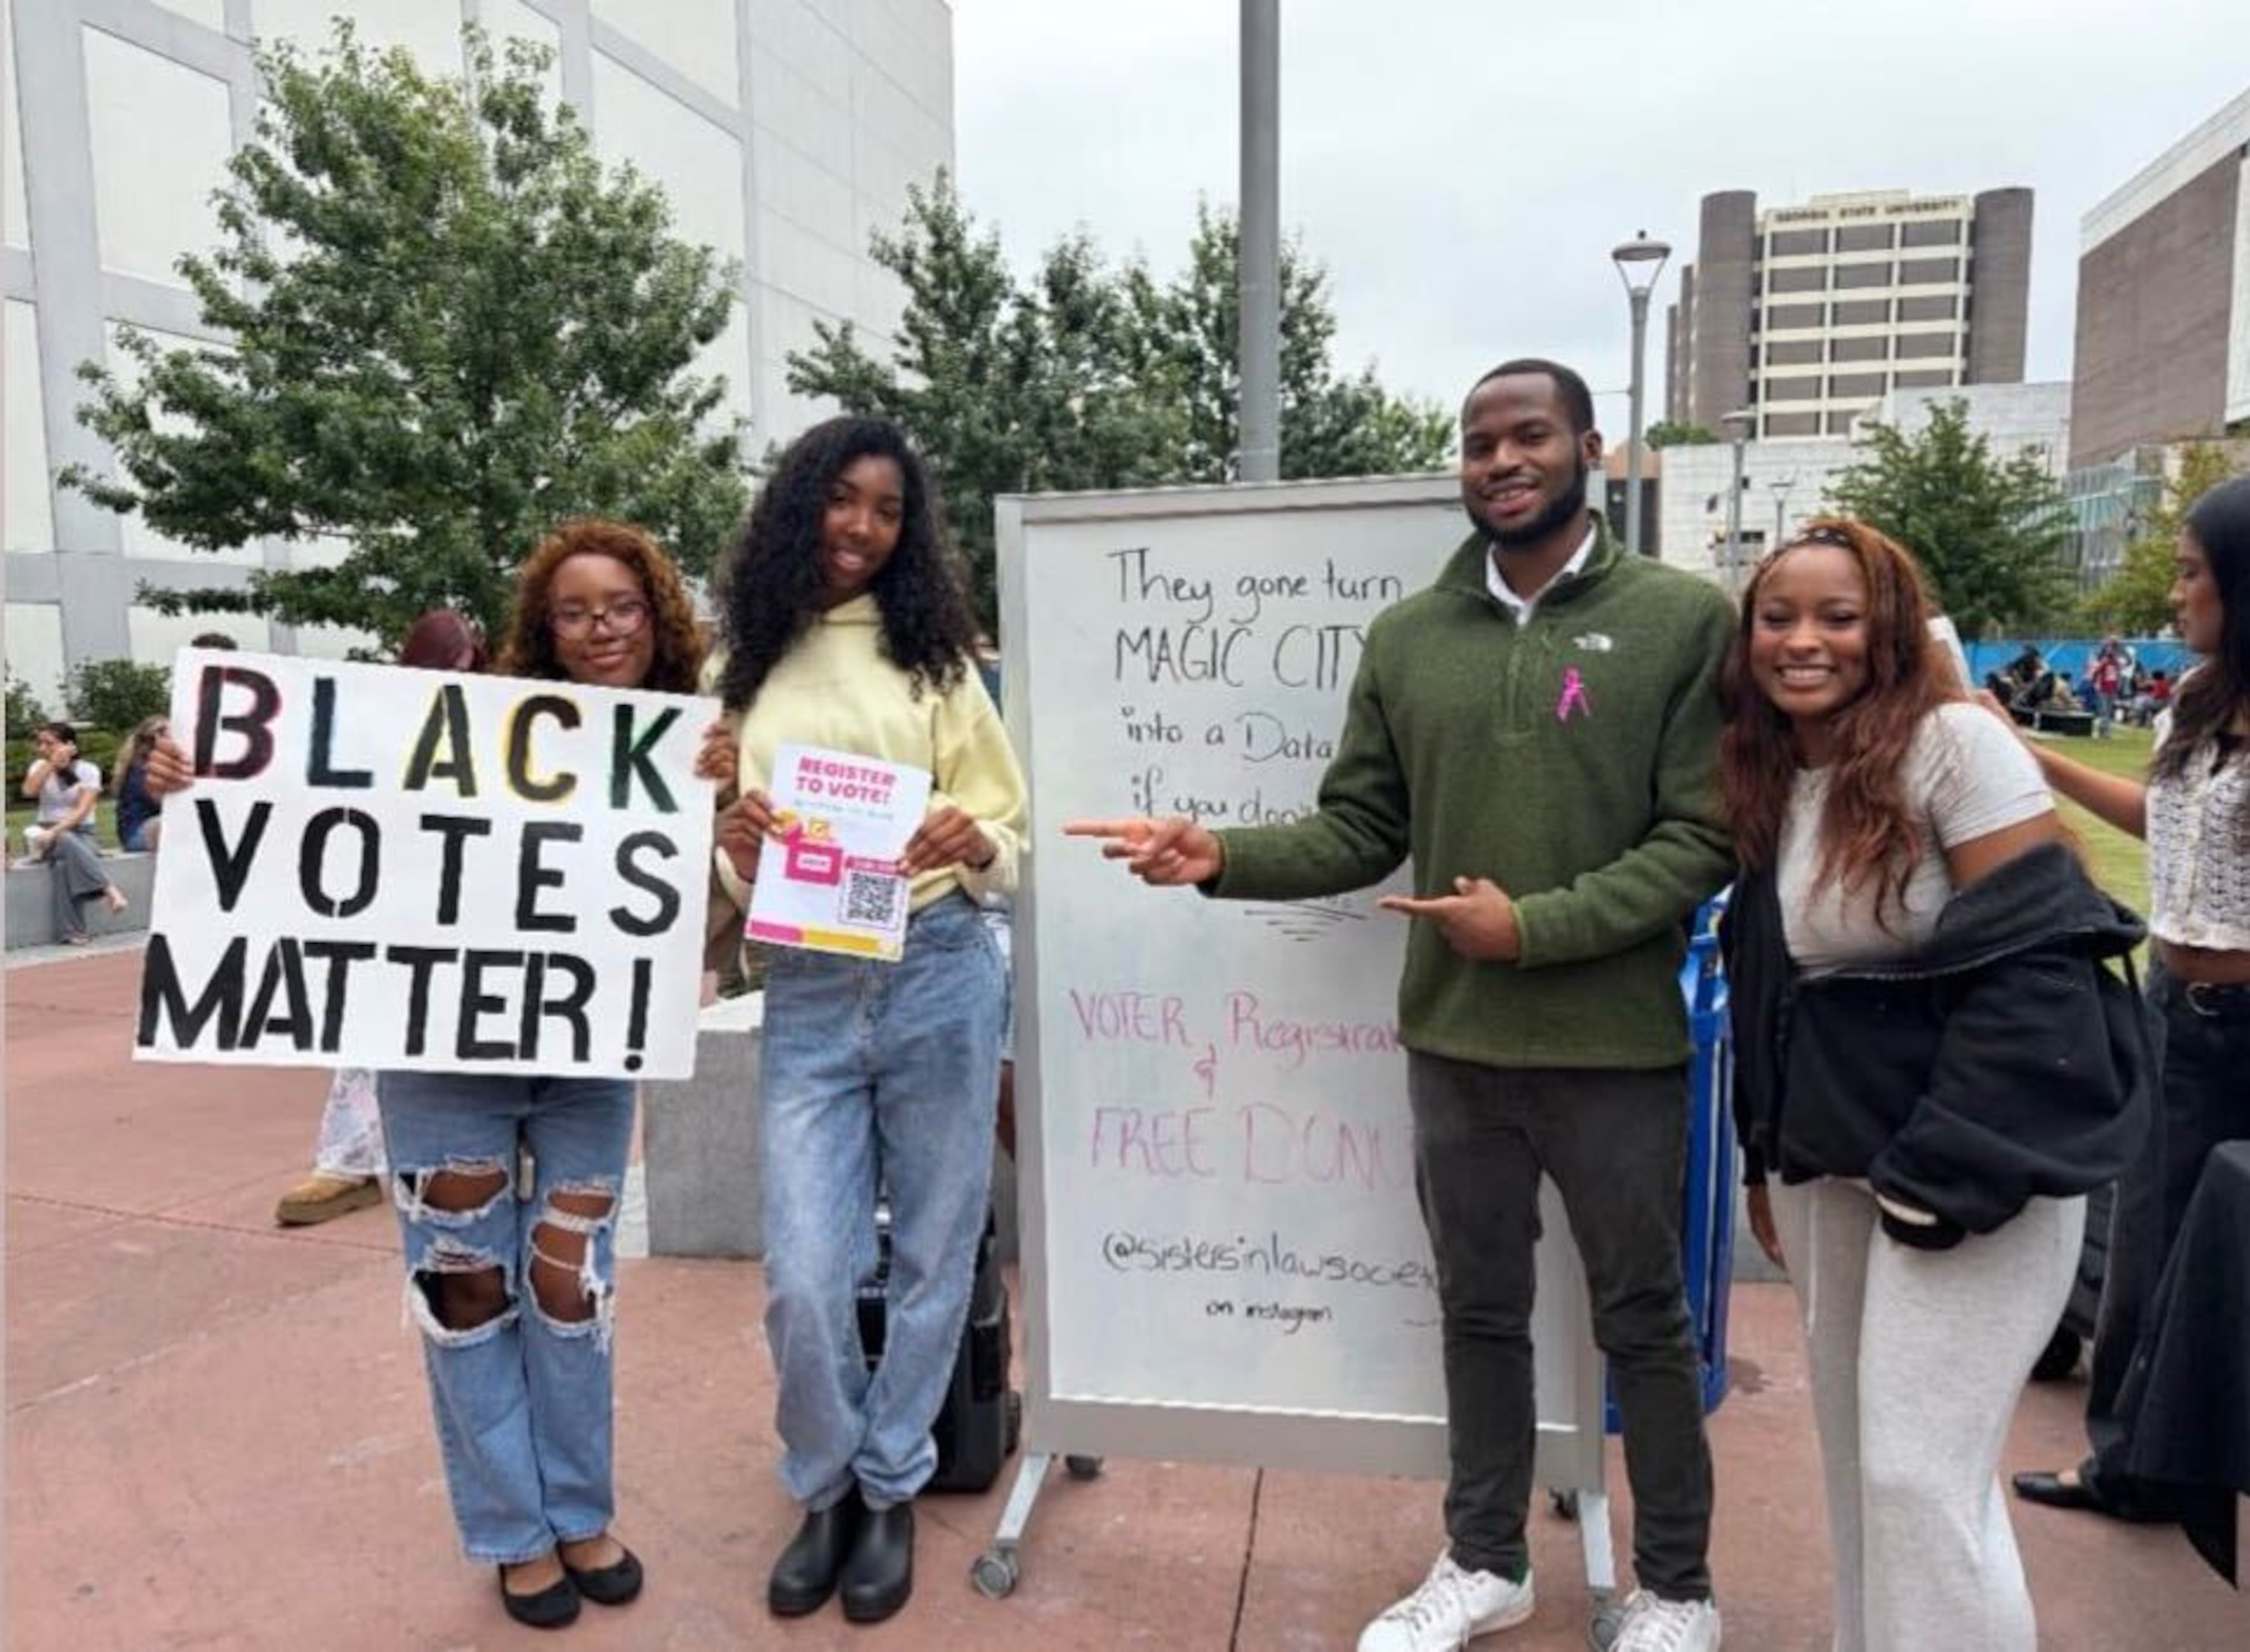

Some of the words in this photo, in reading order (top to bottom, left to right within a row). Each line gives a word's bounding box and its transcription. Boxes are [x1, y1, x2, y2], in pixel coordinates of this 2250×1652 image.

[1109, 549, 1213, 623] They
[1231, 574, 1308, 623] gone
[1322, 559, 1403, 602] turn
[1115, 625, 1254, 687] MAGIC
[193, 665, 684, 813] BLACK
[1121, 706, 1182, 743] into
[1205, 726, 1225, 745] a
[1236, 712, 1332, 763] Data
[797, 777, 823, 793] TO
[829, 782, 890, 805] VOTE!
[799, 756, 896, 785] REGISTER
[1132, 765, 1164, 817] if
[1174, 796, 1228, 823] you
[1240, 788, 1313, 824] don'
[195, 799, 680, 936] VOTES
[138, 931, 652, 1071] MATTER!
[1071, 990, 1188, 1046] VOTER
[1093, 1107, 1216, 1176] FREE
[1206, 1302, 1234, 1316] on
